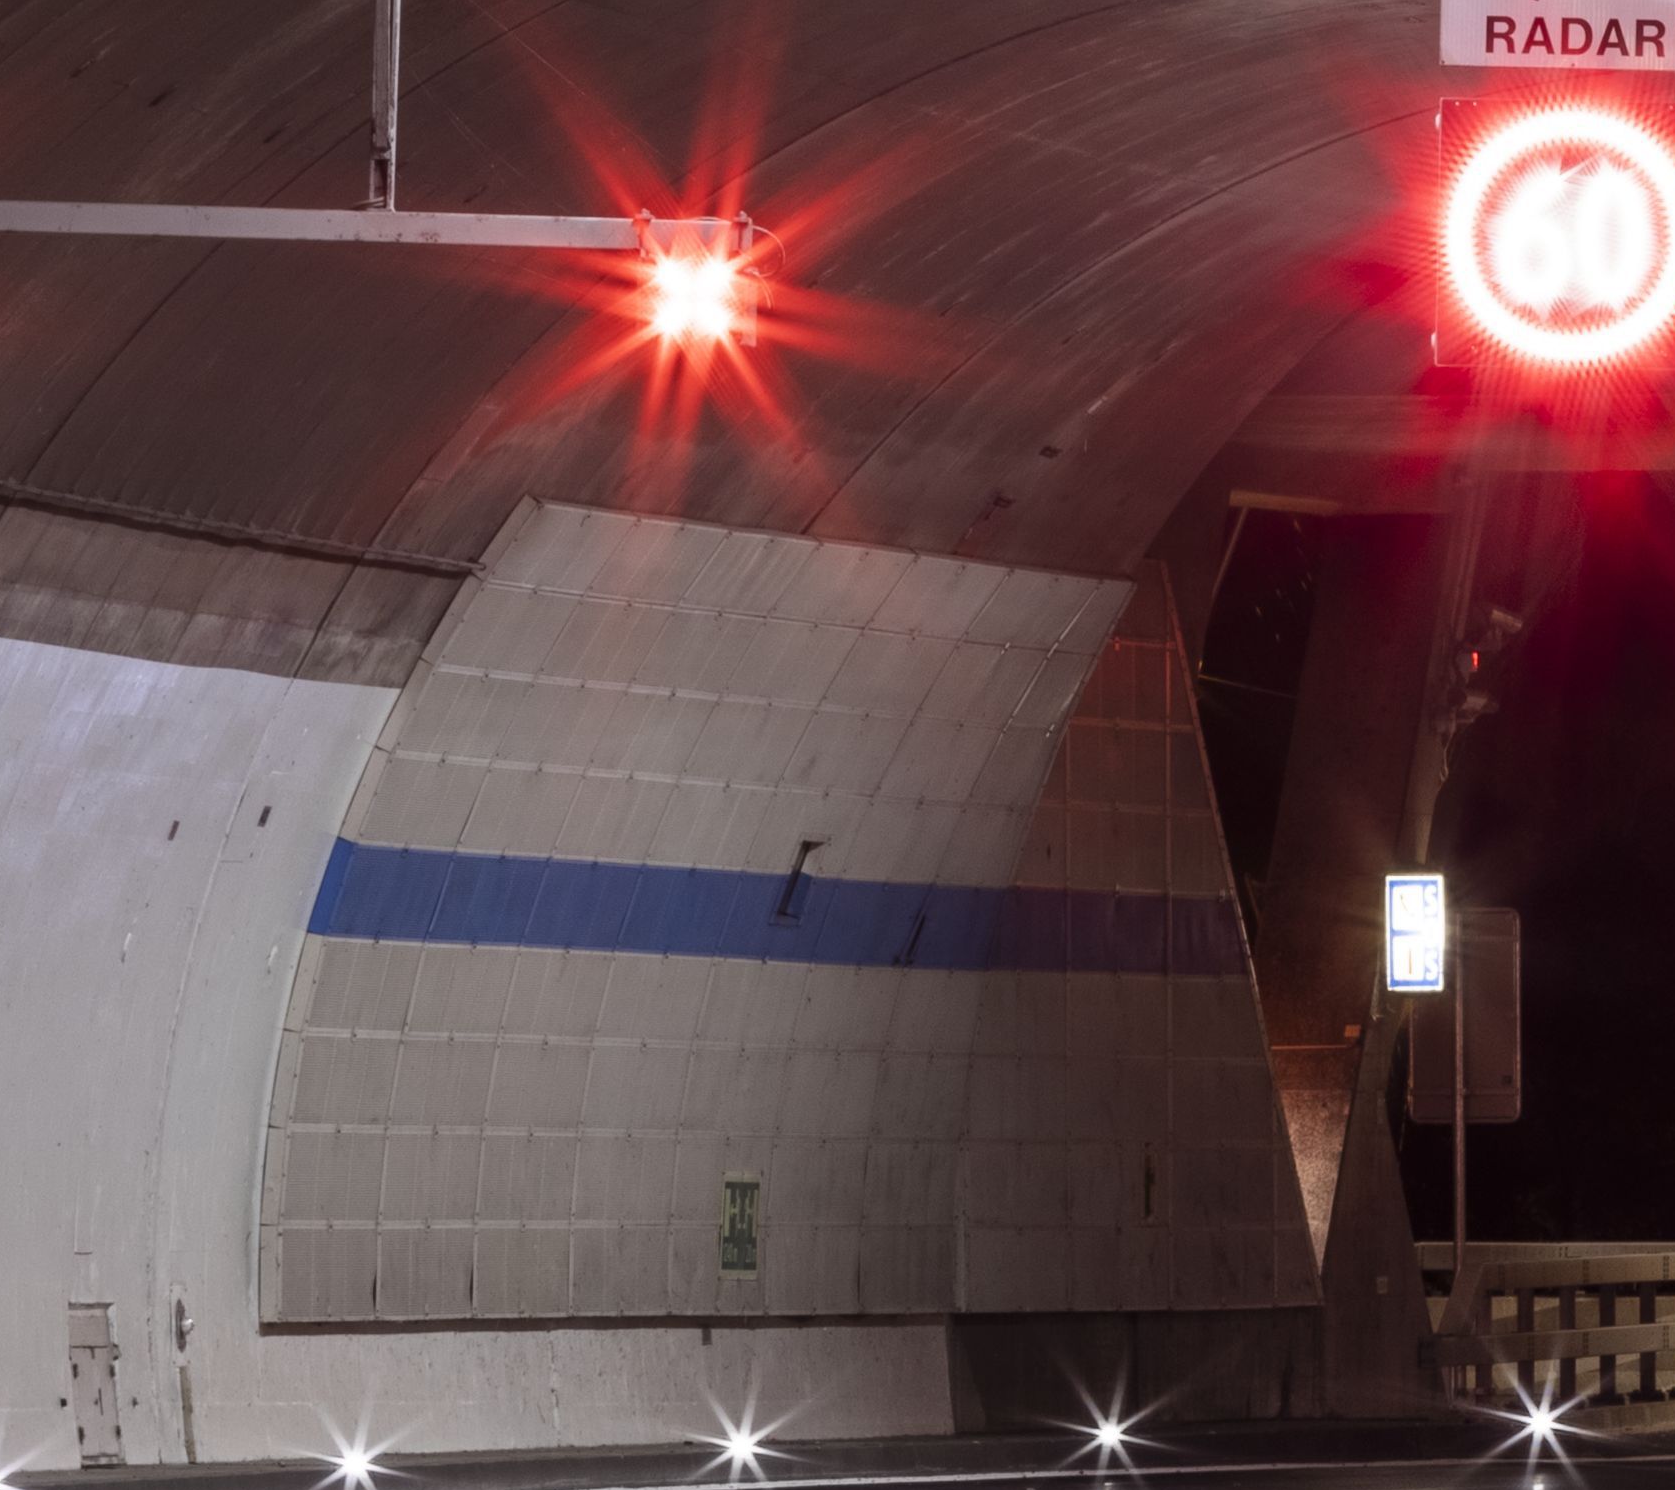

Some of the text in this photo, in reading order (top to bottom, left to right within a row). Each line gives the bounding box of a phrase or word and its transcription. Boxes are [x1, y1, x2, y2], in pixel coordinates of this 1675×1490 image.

[1485, 15, 1666, 57] RADAR
[1492, 157, 1652, 311] 60
[1423, 884, 1439, 982] SS
